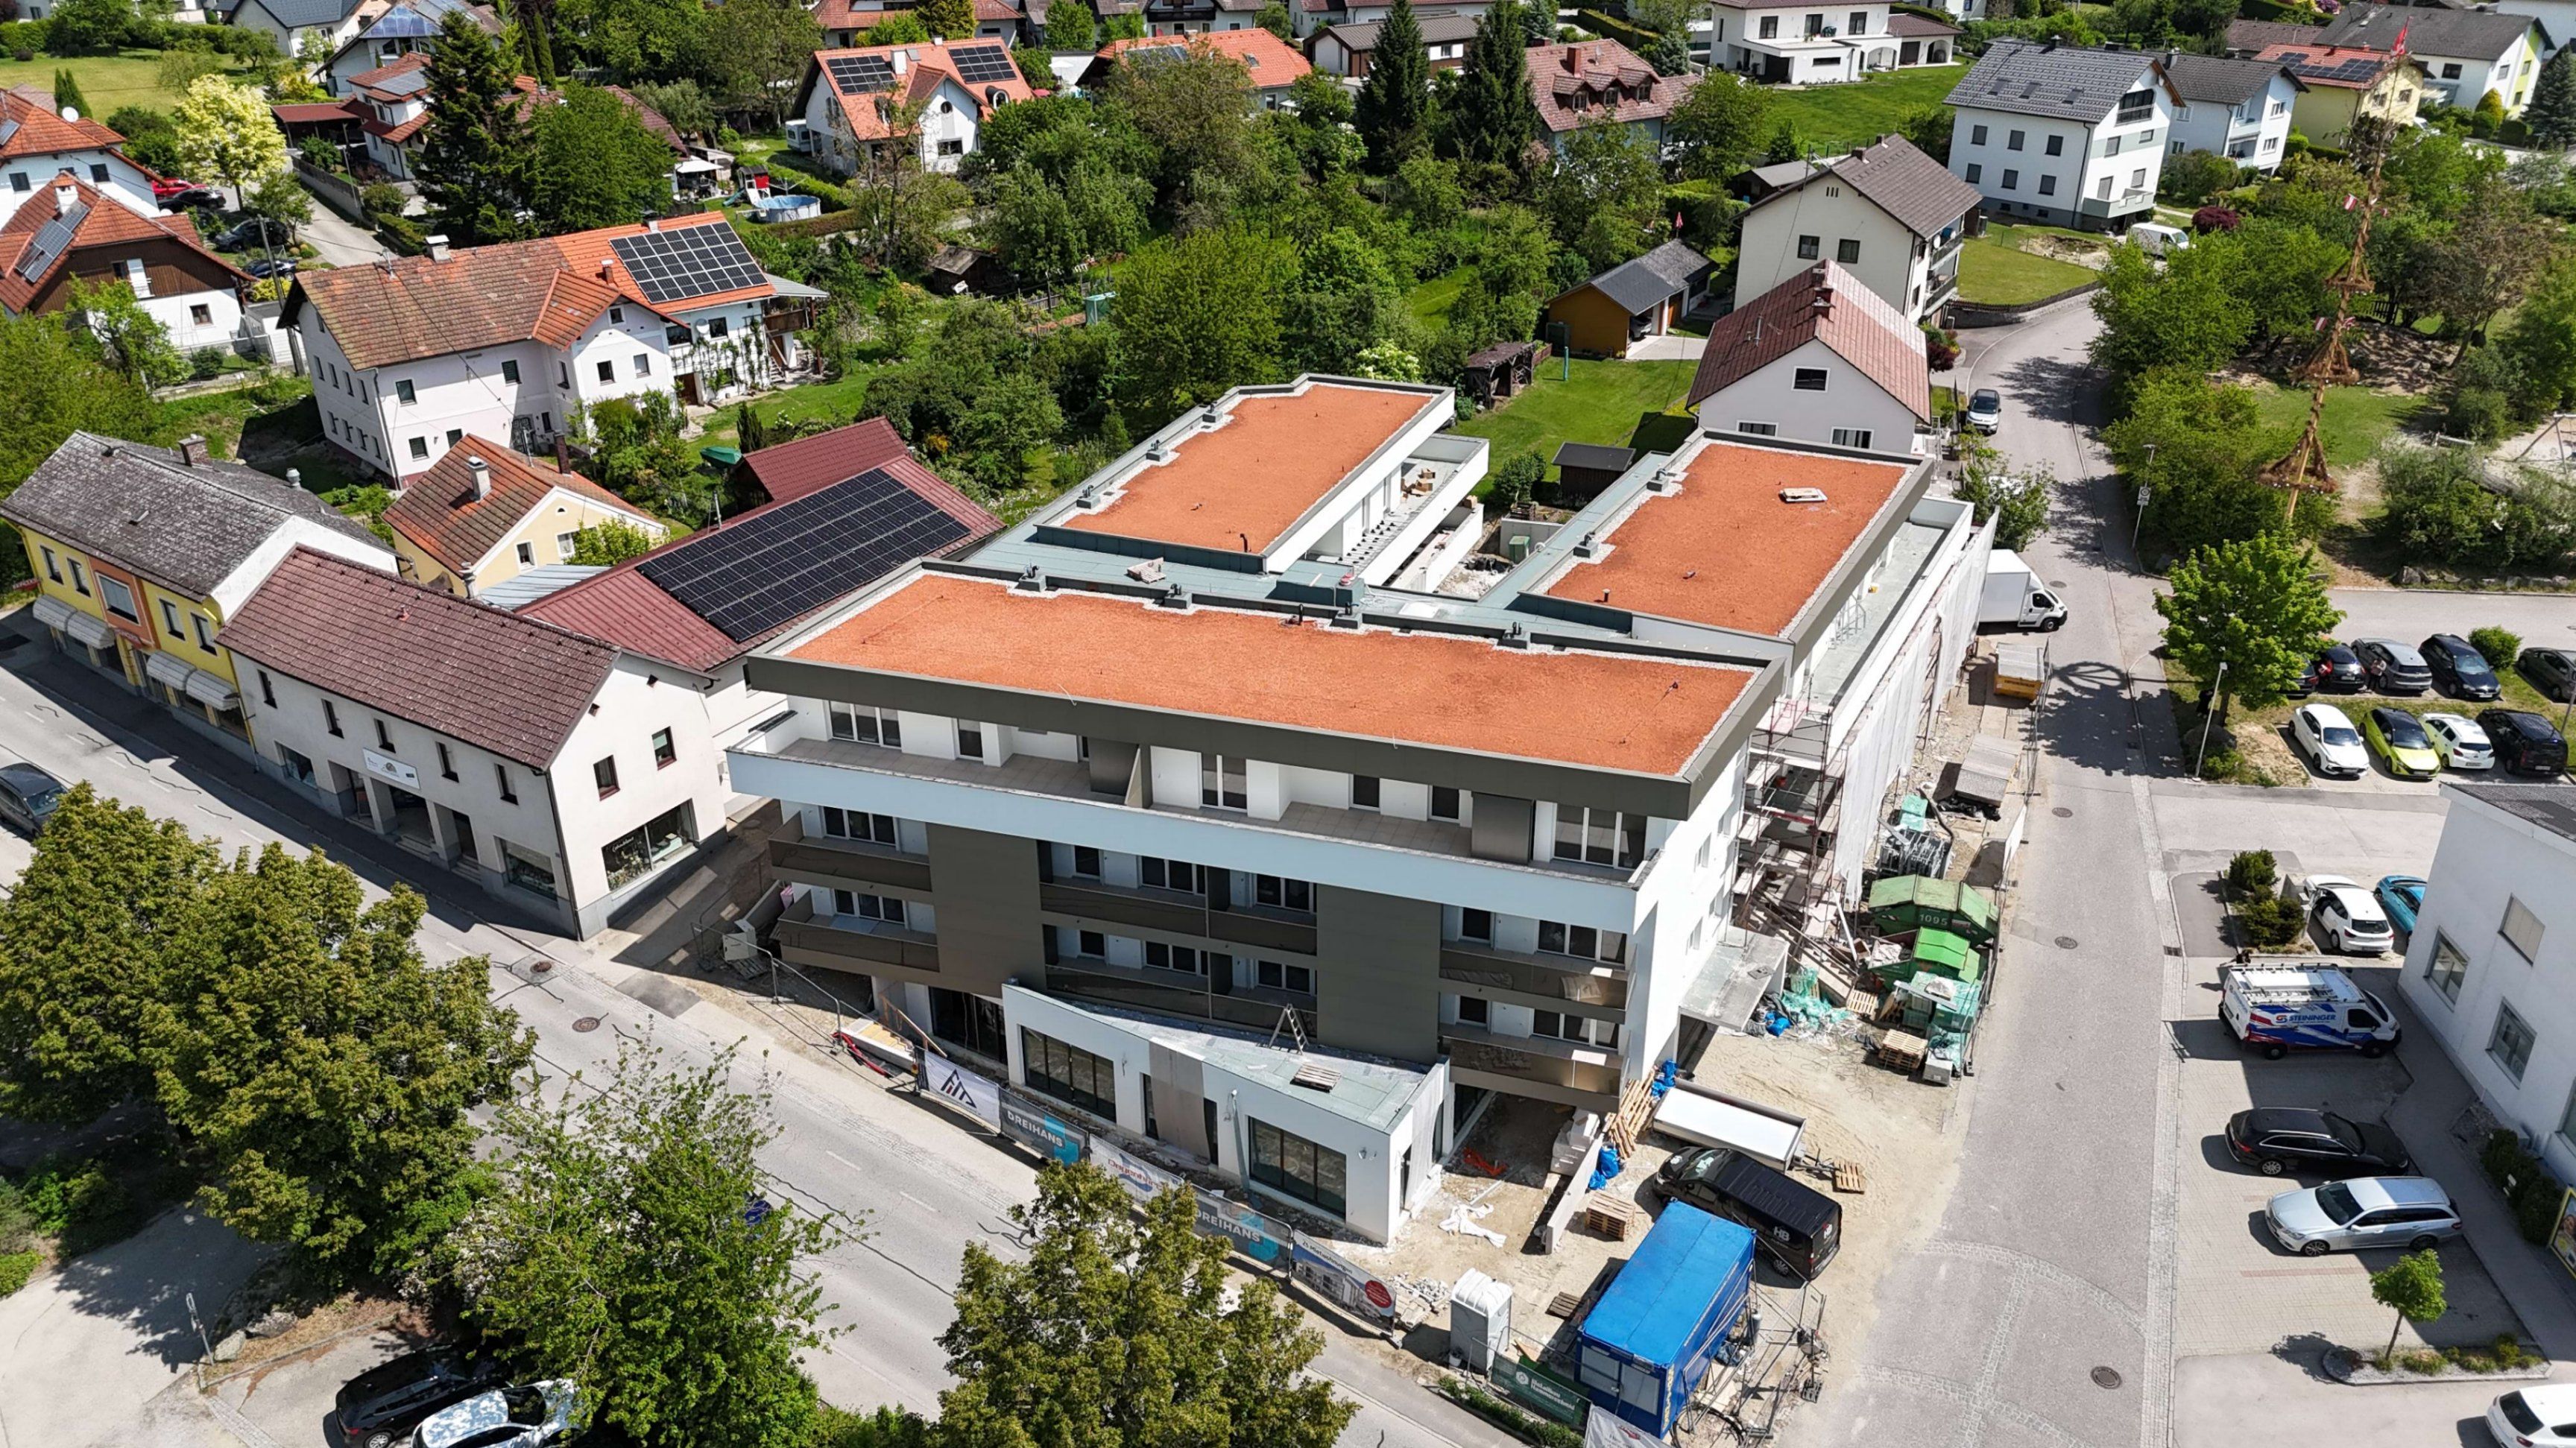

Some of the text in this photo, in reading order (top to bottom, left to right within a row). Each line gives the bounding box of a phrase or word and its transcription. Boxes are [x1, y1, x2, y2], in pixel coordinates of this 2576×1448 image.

[1919, 914, 1948, 926] 1095
[1007, 1110, 1063, 1147] DREIHANS
[1773, 1226, 1790, 1242] HB
